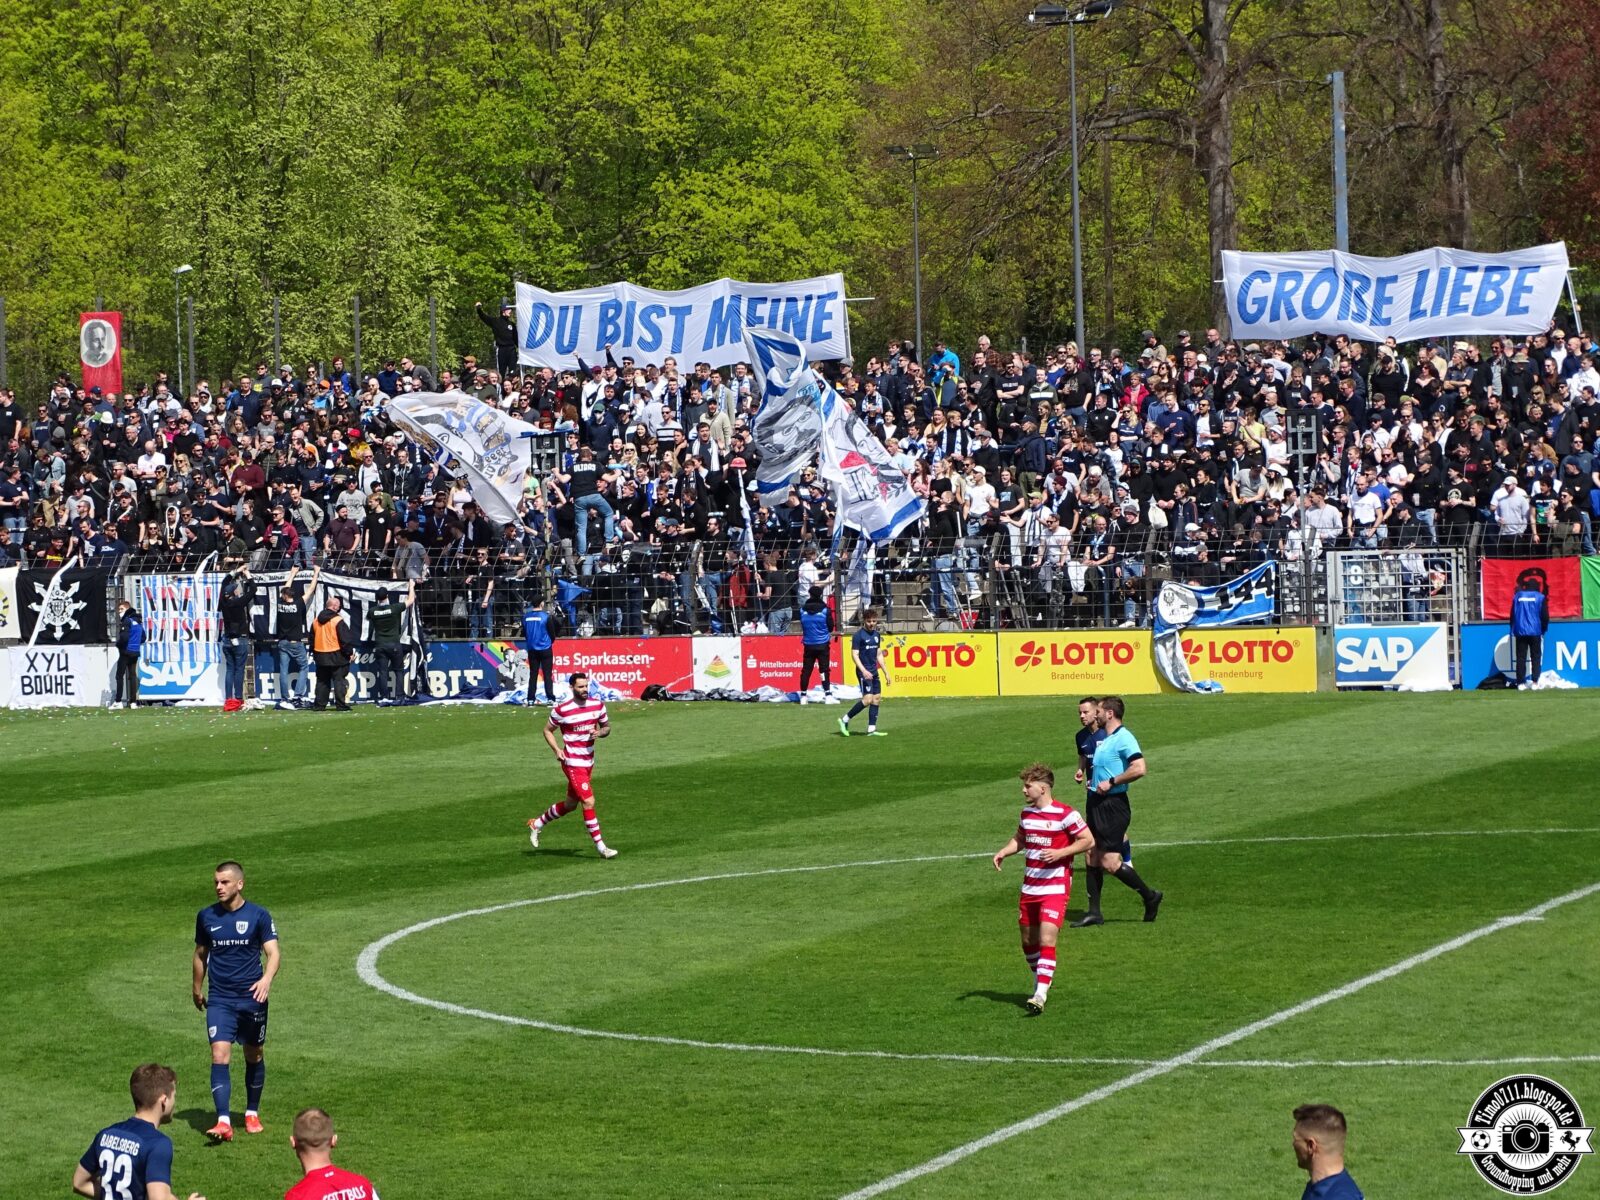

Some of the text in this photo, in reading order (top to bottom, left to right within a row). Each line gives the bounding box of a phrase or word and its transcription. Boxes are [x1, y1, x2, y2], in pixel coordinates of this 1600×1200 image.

[1408, 265, 1541, 322] LIEBE
[525, 290, 838, 356] DU BIST MEINE
[573, 651, 655, 668] Sparkassen-
[893, 644, 976, 668] LOTTO
[1050, 642, 1134, 665] LOTTO
[1208, 639, 1294, 663] LOTTO
[1336, 636, 1415, 673] SAP
[139, 660, 205, 687] SAP
[759, 670, 793, 680] Sparkasse
[894, 674, 946, 683] Brandenburg
[1051, 672, 1105, 682] Brandenburg
[1209, 670, 1263, 679] Brandenburg
[100, 1133, 140, 1156] BABELSBERG
[99, 1149, 133, 1200] 33
